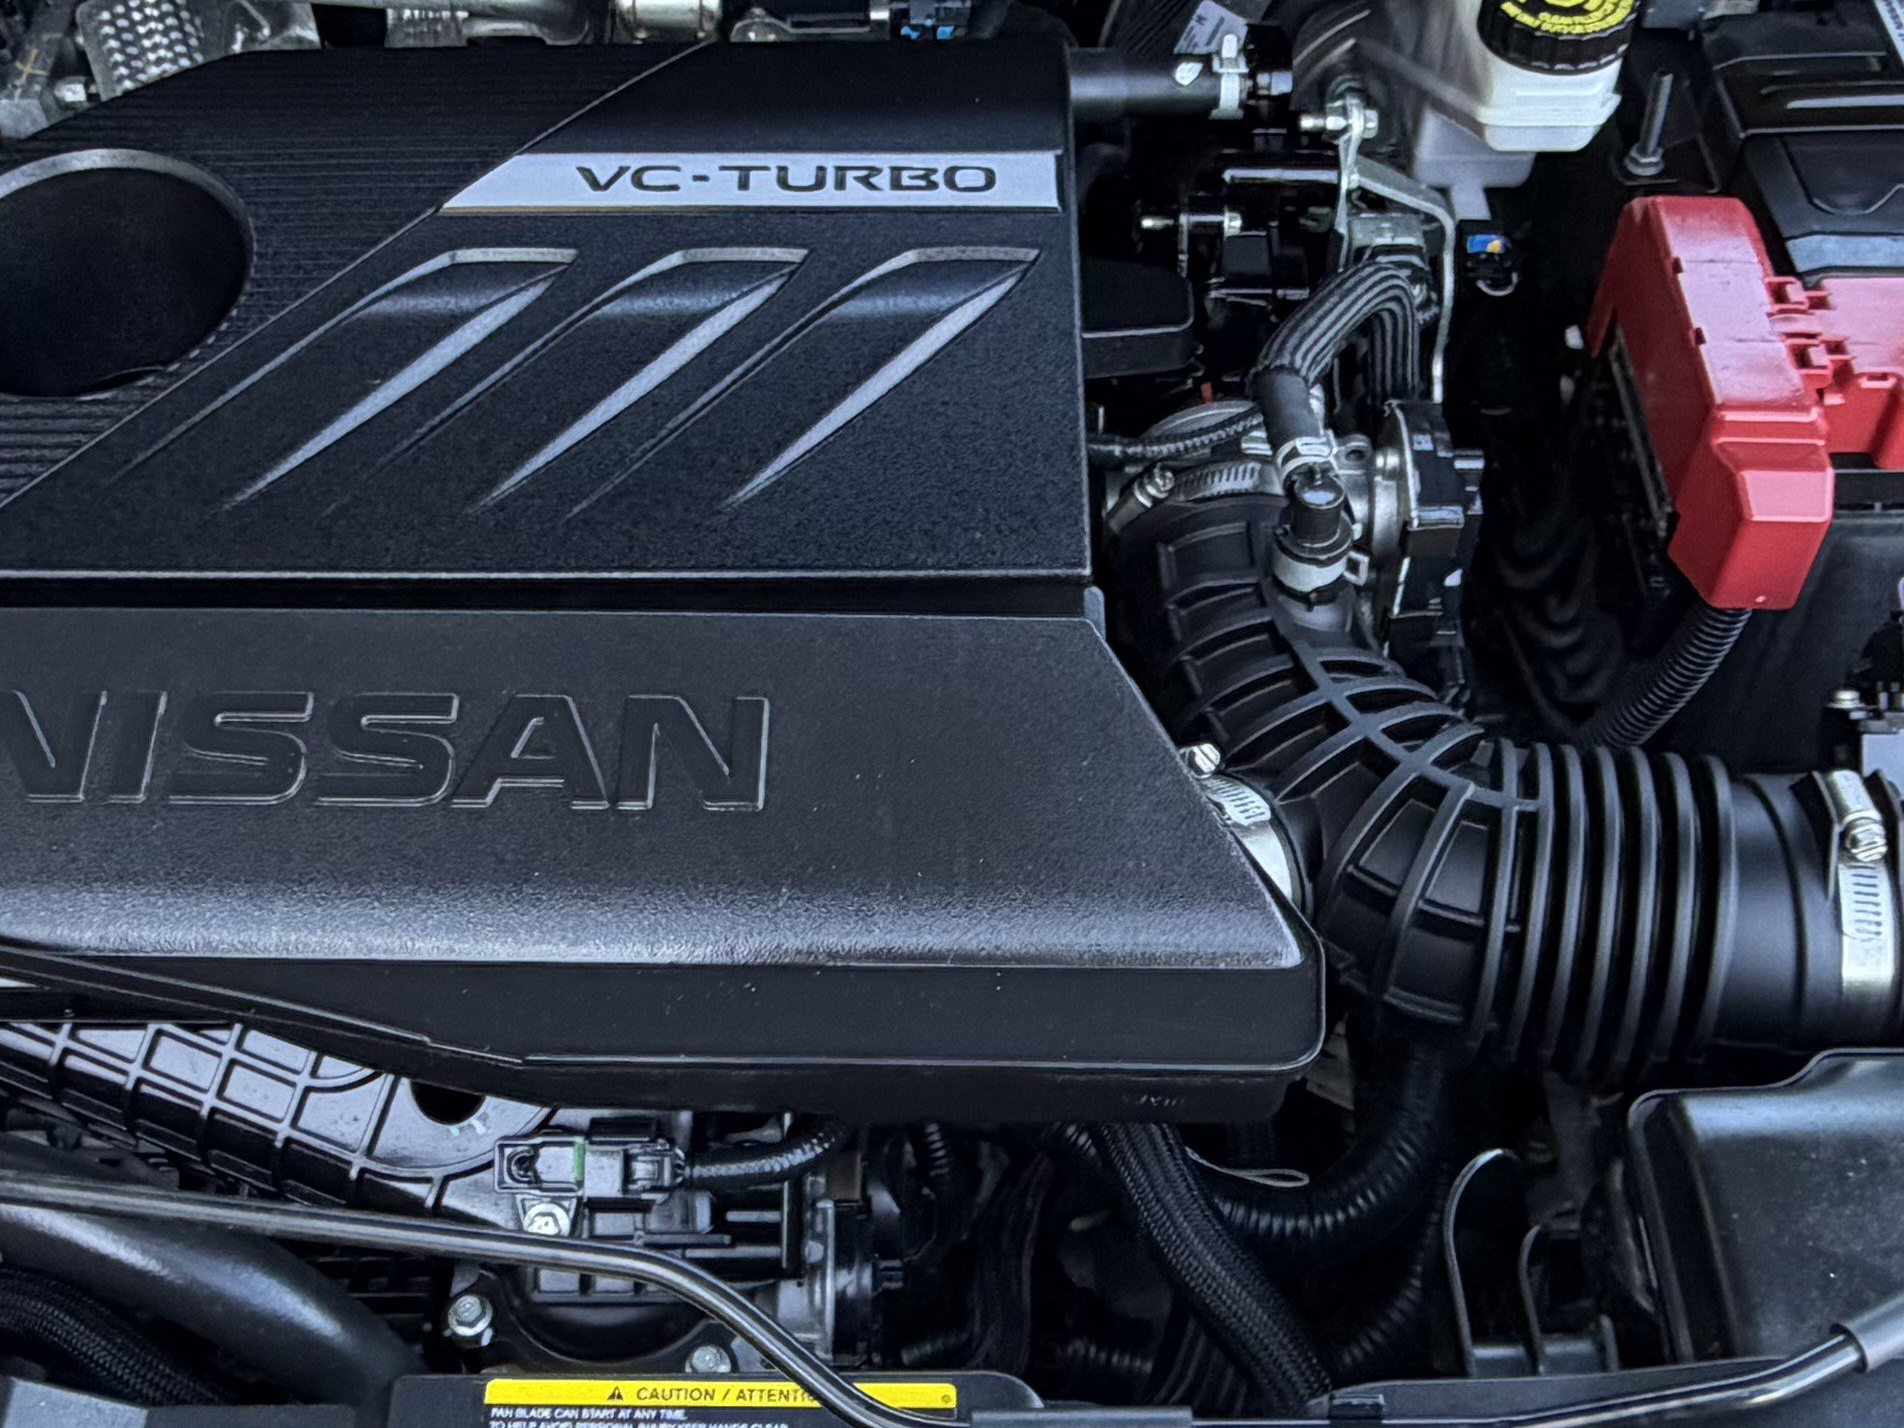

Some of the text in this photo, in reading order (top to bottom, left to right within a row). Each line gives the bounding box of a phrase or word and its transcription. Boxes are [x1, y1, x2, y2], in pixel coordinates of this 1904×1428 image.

[575, 164, 997, 193] VC-TURBO
[636, 1387, 716, 1401] CAUTION
[736, 1388, 816, 1403] ATTENTI
[515, 1408, 552, 1419] BLADE
[554, 1408, 579, 1419] CAN
[618, 1409, 632, 1420] AT
[633, 1409, 657, 1420] ANY
